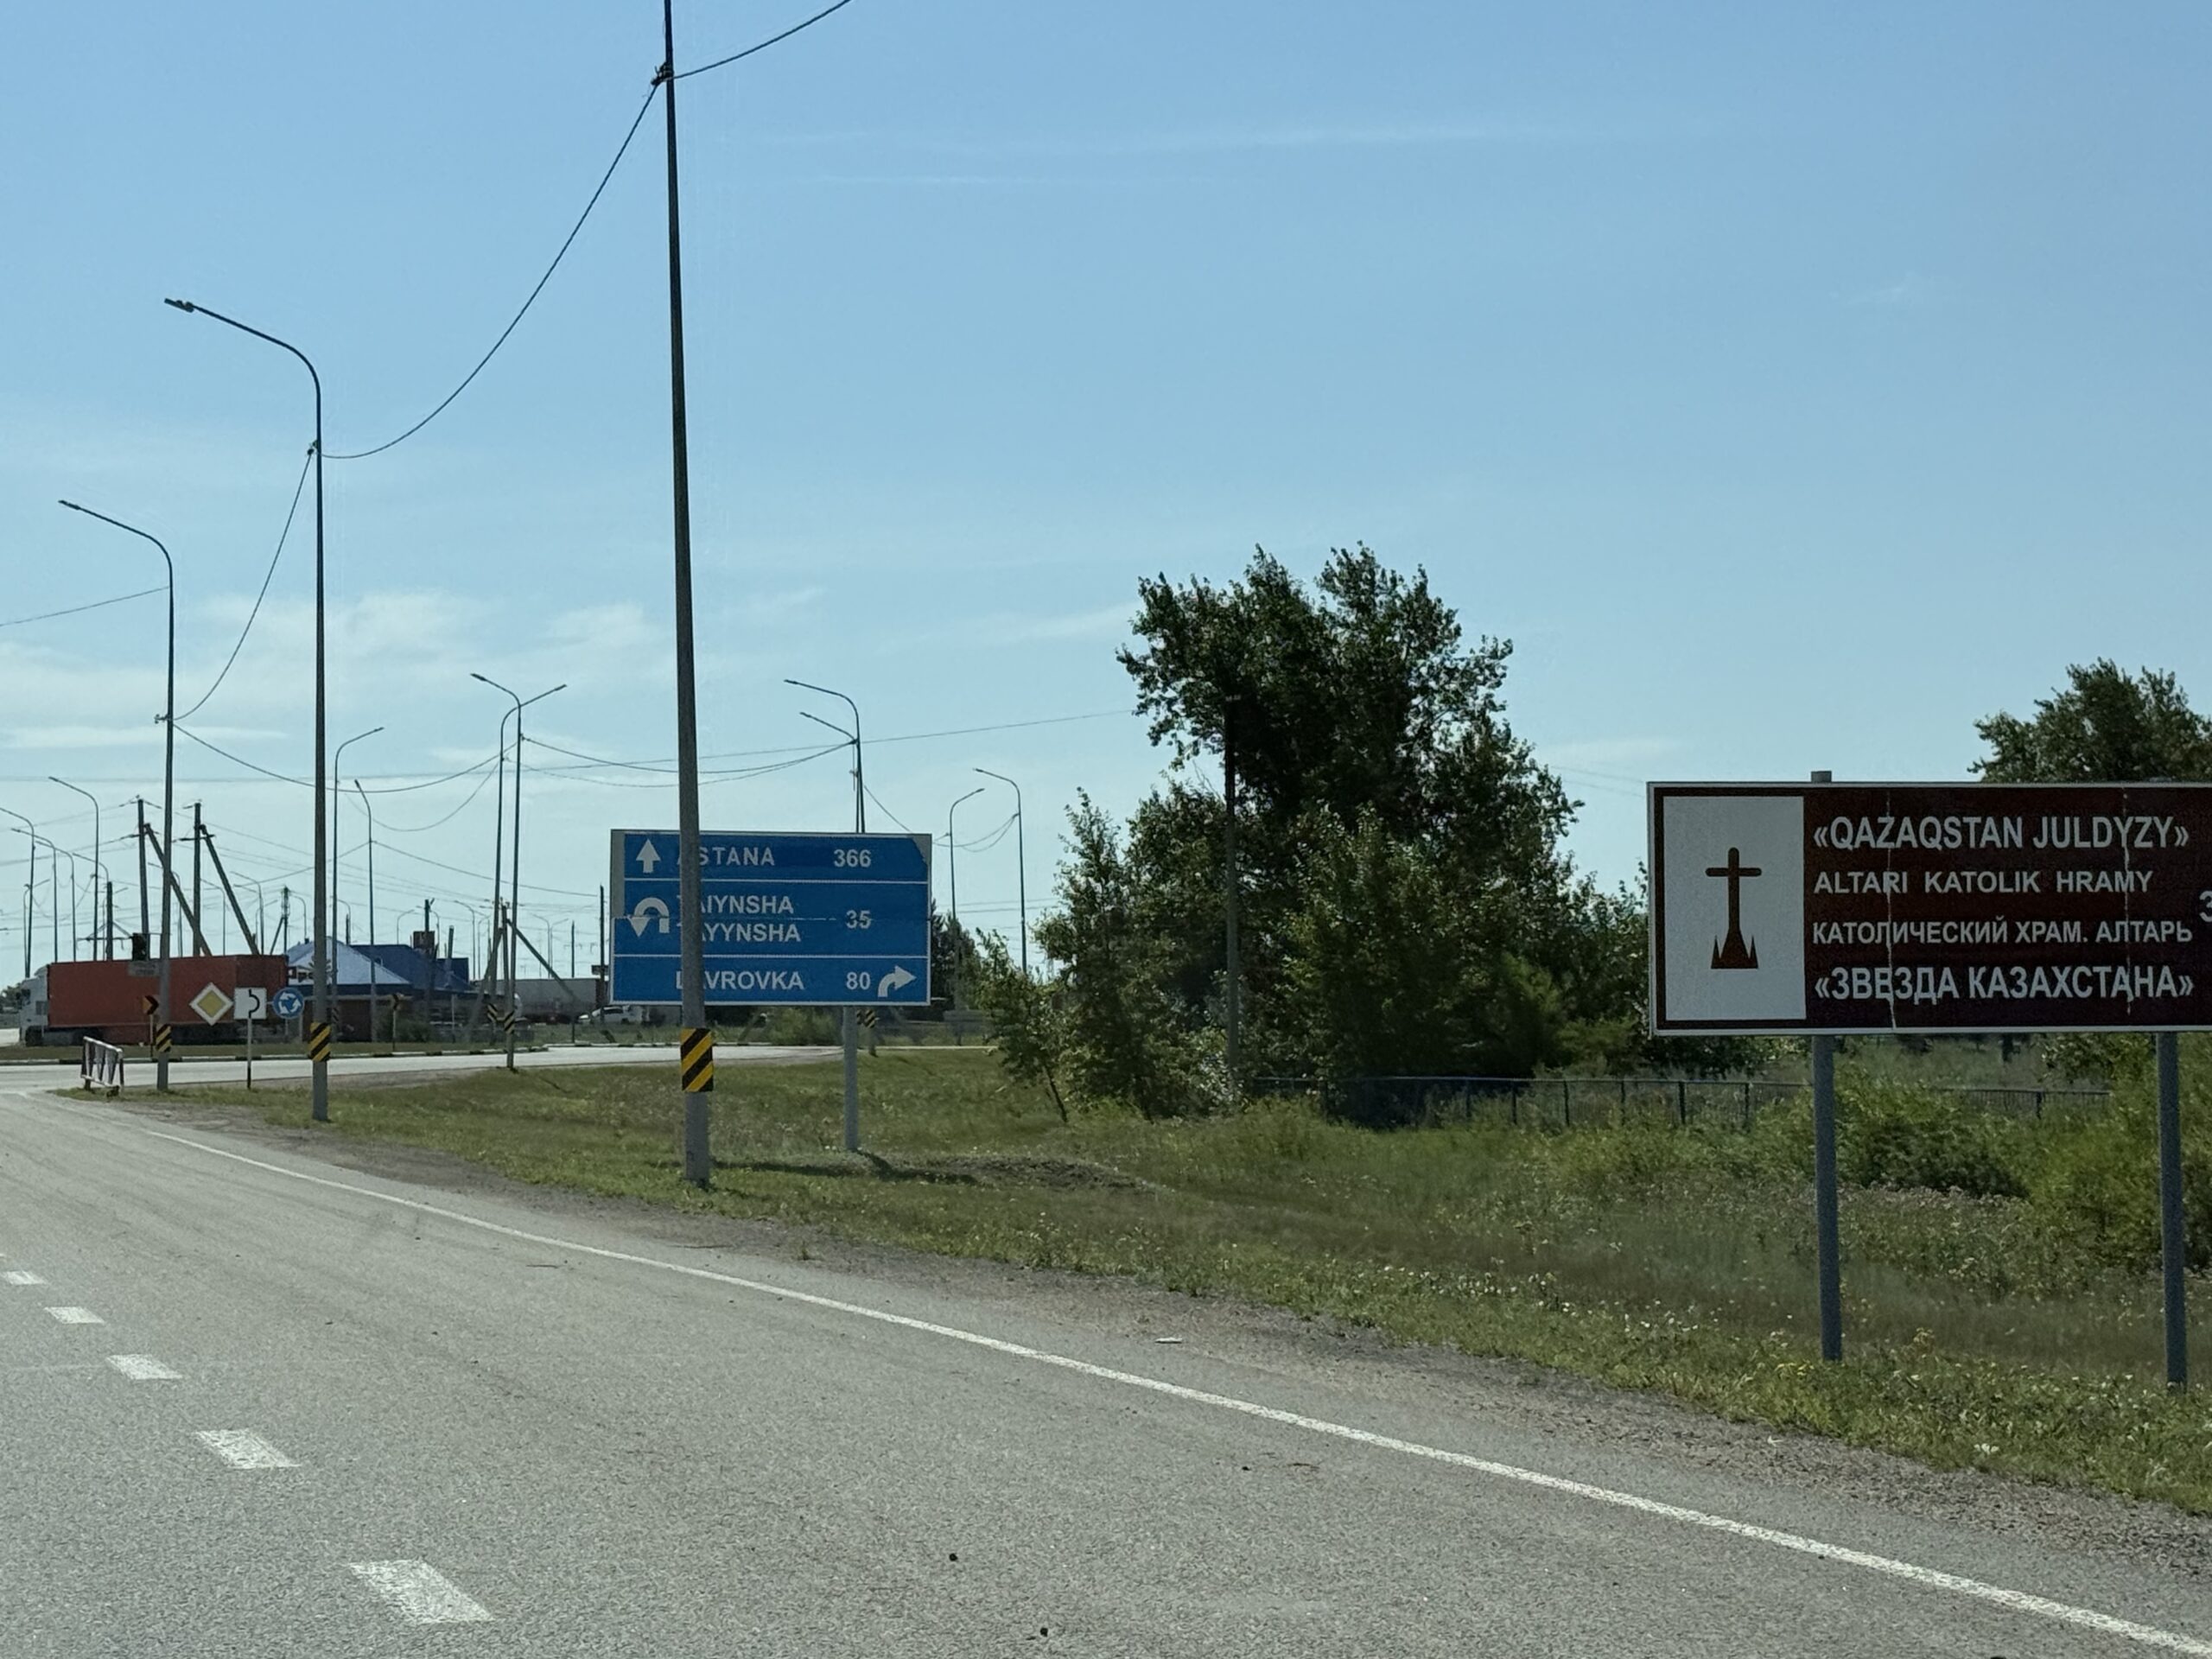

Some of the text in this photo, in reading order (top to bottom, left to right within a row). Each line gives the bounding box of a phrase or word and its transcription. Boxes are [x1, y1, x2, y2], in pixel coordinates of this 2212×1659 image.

[1814, 816, 2189, 850] «QAZAQSTAN JULDYZY»
[677, 847, 872, 868] STANA 366
[1814, 871, 2153, 893] ALTARI KATOLIK HRAMY
[677, 894, 794, 914] IYNSHA
[846, 910, 872, 929] 35
[1813, 915, 2192, 944] КАТОЛИЧЕСКИЙ ХРАМ. АЛТАРЬ
[677, 922, 801, 942] YYNSHA
[676, 970, 871, 990] LVROVKA 80
[1815, 965, 2195, 1005] «ЗВЕЗДА КАЗАХСТАНА»
